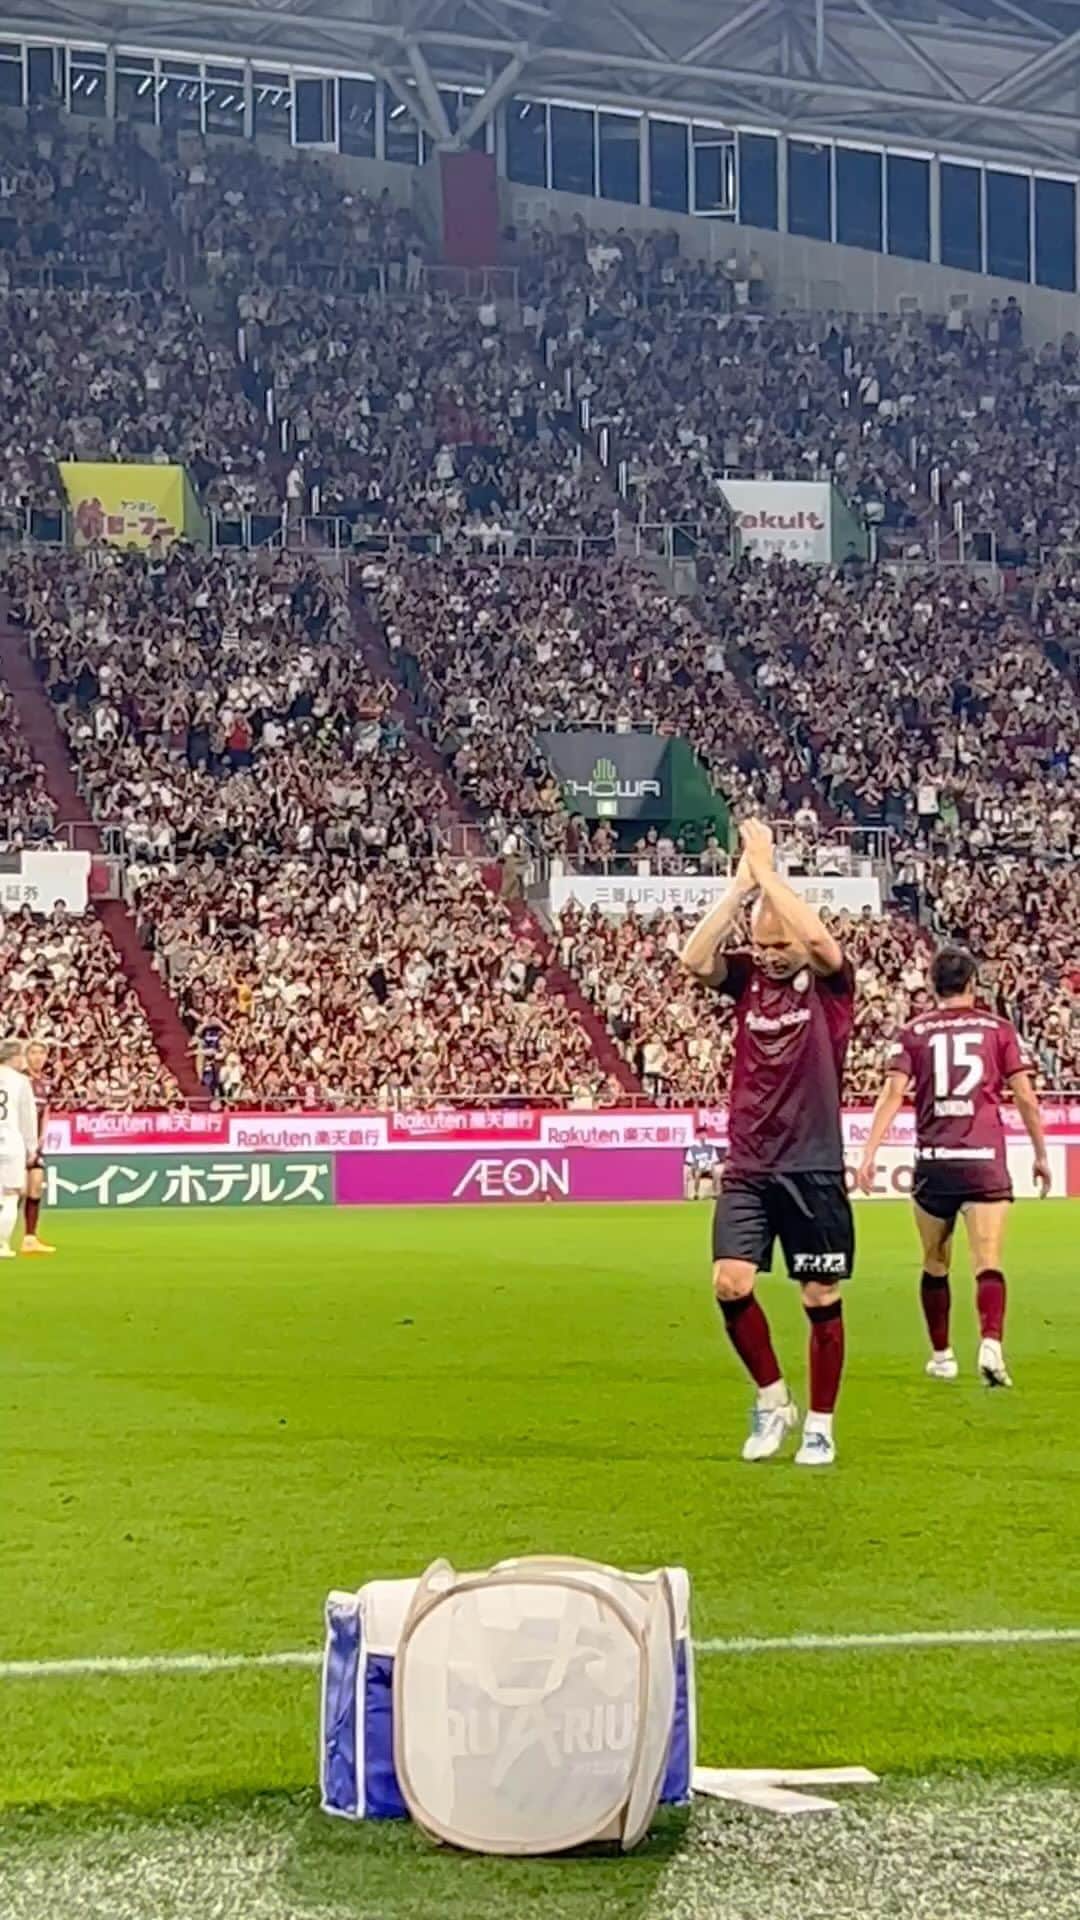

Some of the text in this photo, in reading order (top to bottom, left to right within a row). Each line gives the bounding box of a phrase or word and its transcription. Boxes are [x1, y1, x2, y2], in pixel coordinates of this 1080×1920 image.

[928, 1032, 984, 1097] 15
[237, 1130, 311, 1147] Rakuten
[548, 1127, 620, 1144] Rakuten
[42, 1164, 328, 1206] トインホテルズ
